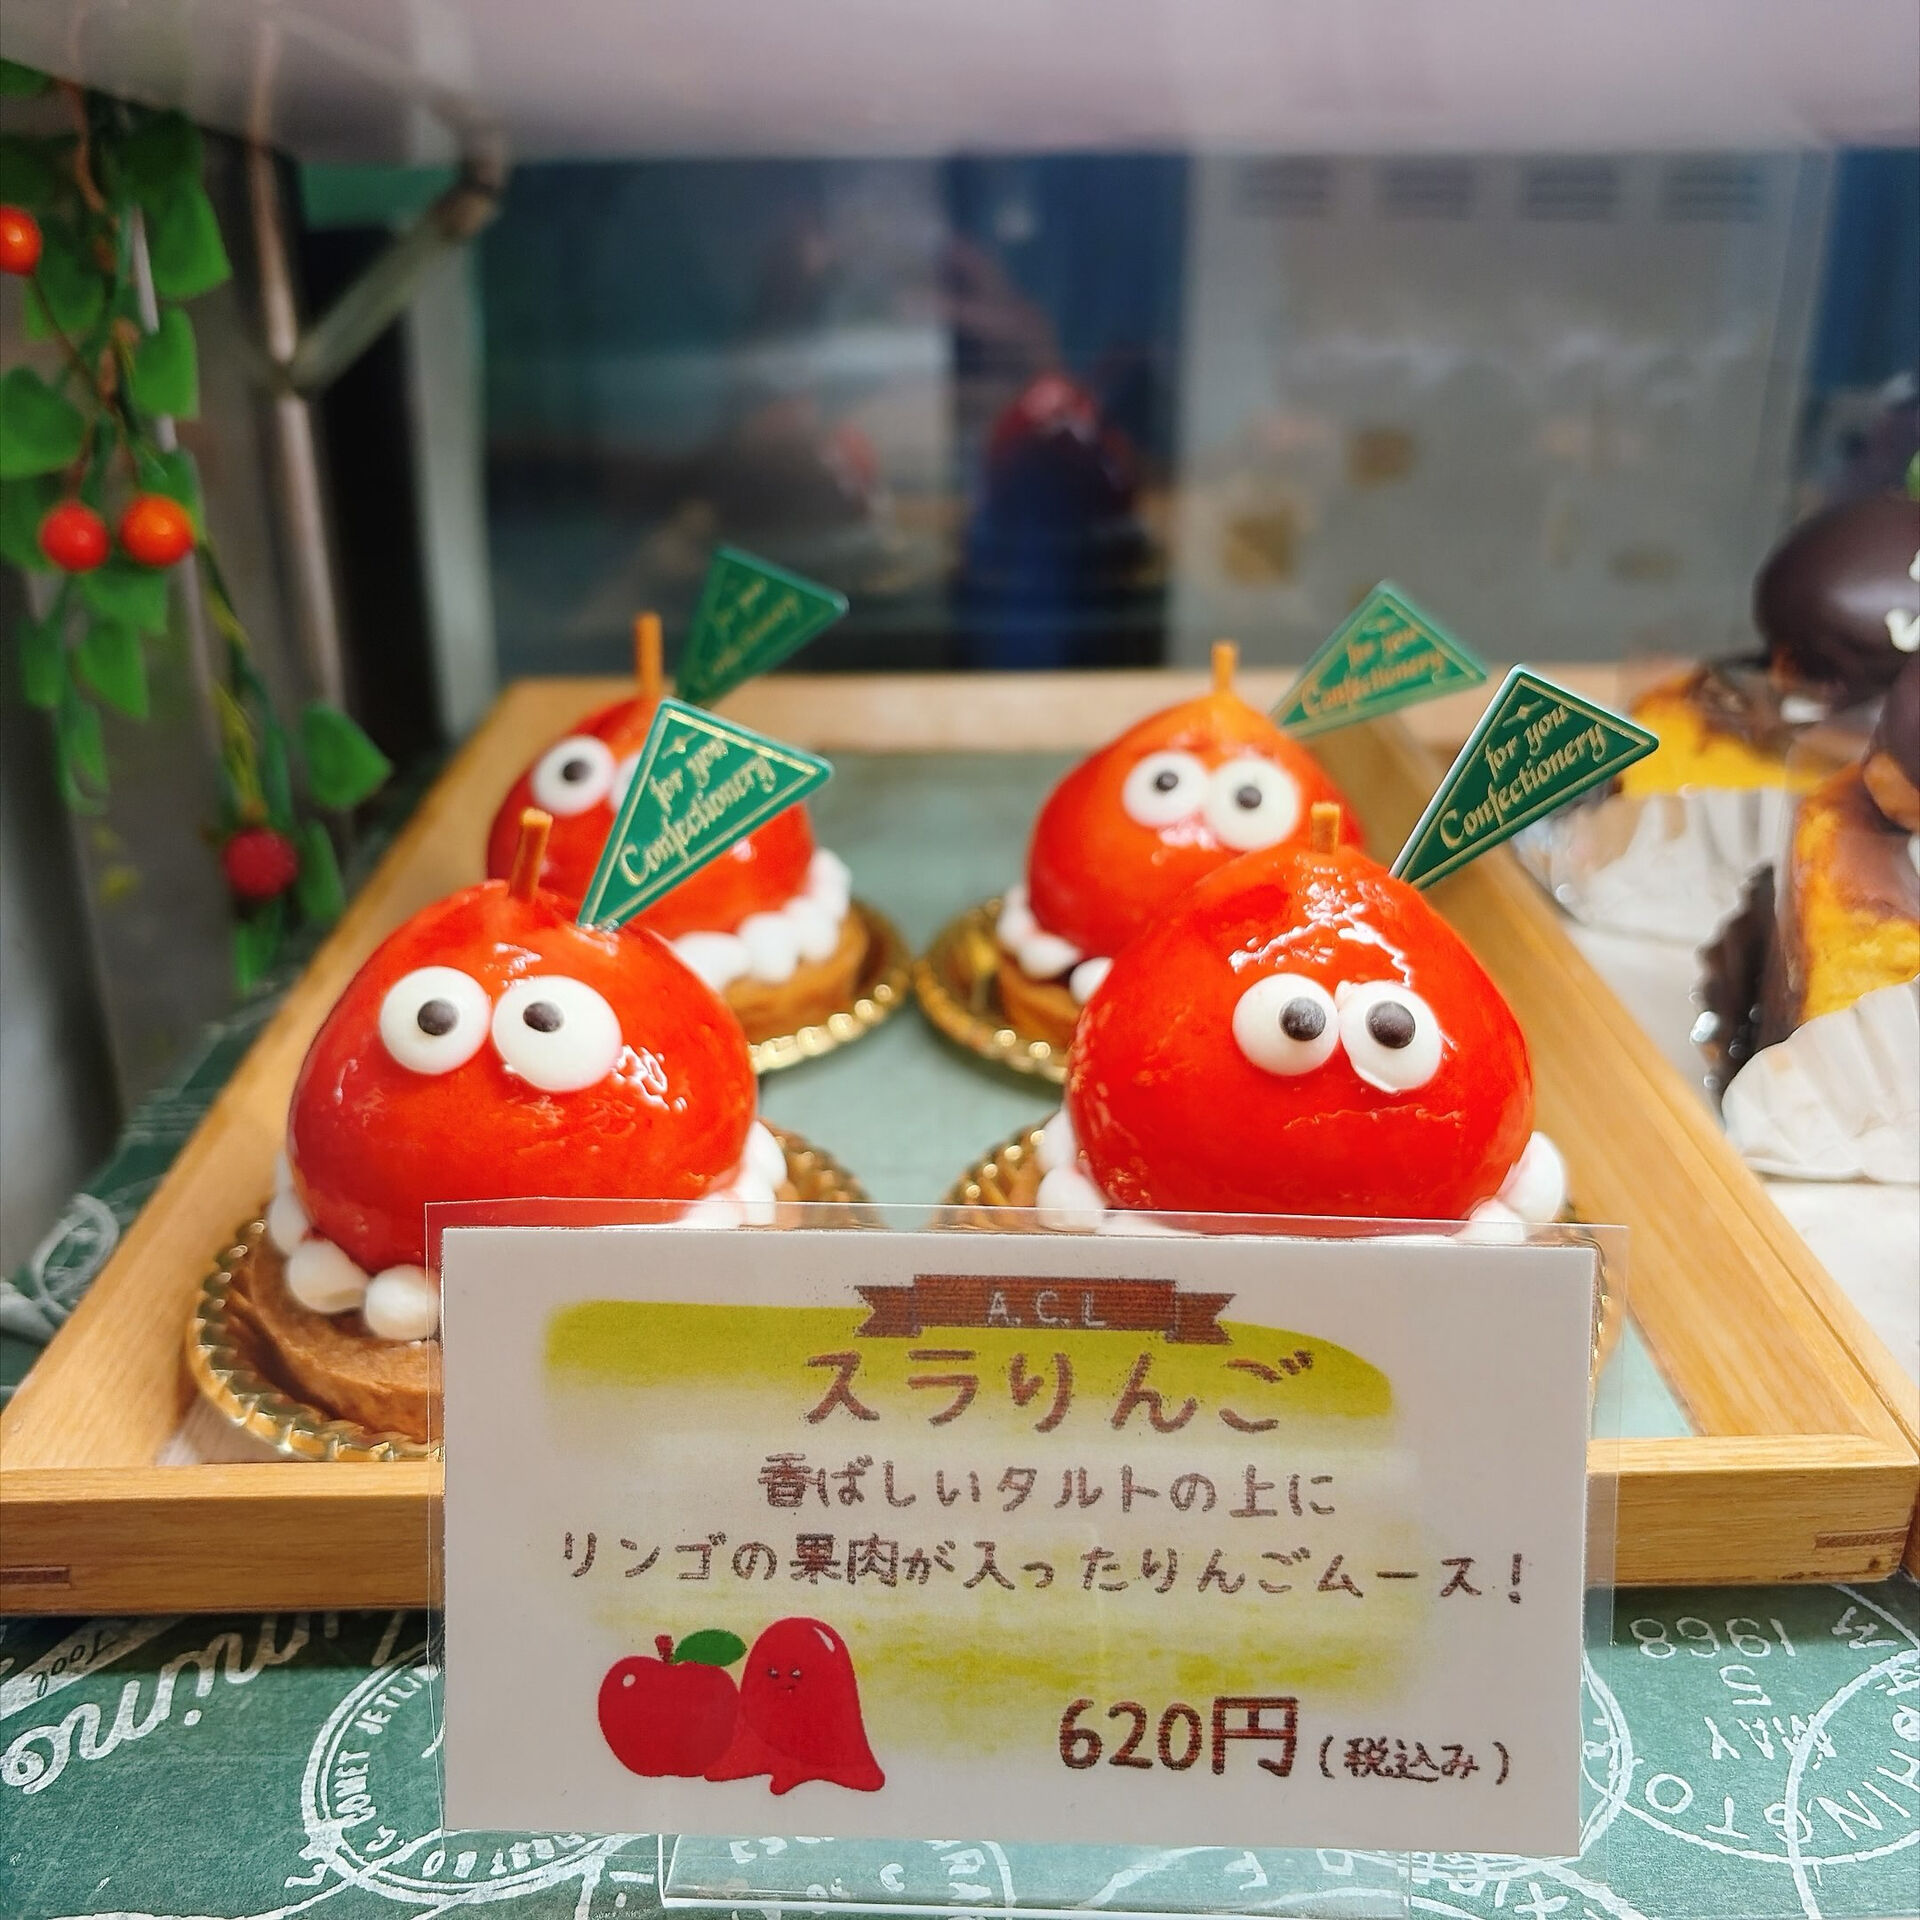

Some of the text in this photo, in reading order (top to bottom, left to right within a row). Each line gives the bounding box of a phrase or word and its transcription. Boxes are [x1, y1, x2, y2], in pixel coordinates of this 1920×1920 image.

[648, 738, 731, 815] for you
[1484, 704, 1570, 780] for you
[619, 755, 778, 886] Confectionery
[1438, 723, 1608, 849] Confectionery
[806, 1348, 1315, 1433] スラりんご
[757, 1452, 1336, 1516] 香ばしいタルトの上に
[1058, 1696, 1298, 1777] 620円
